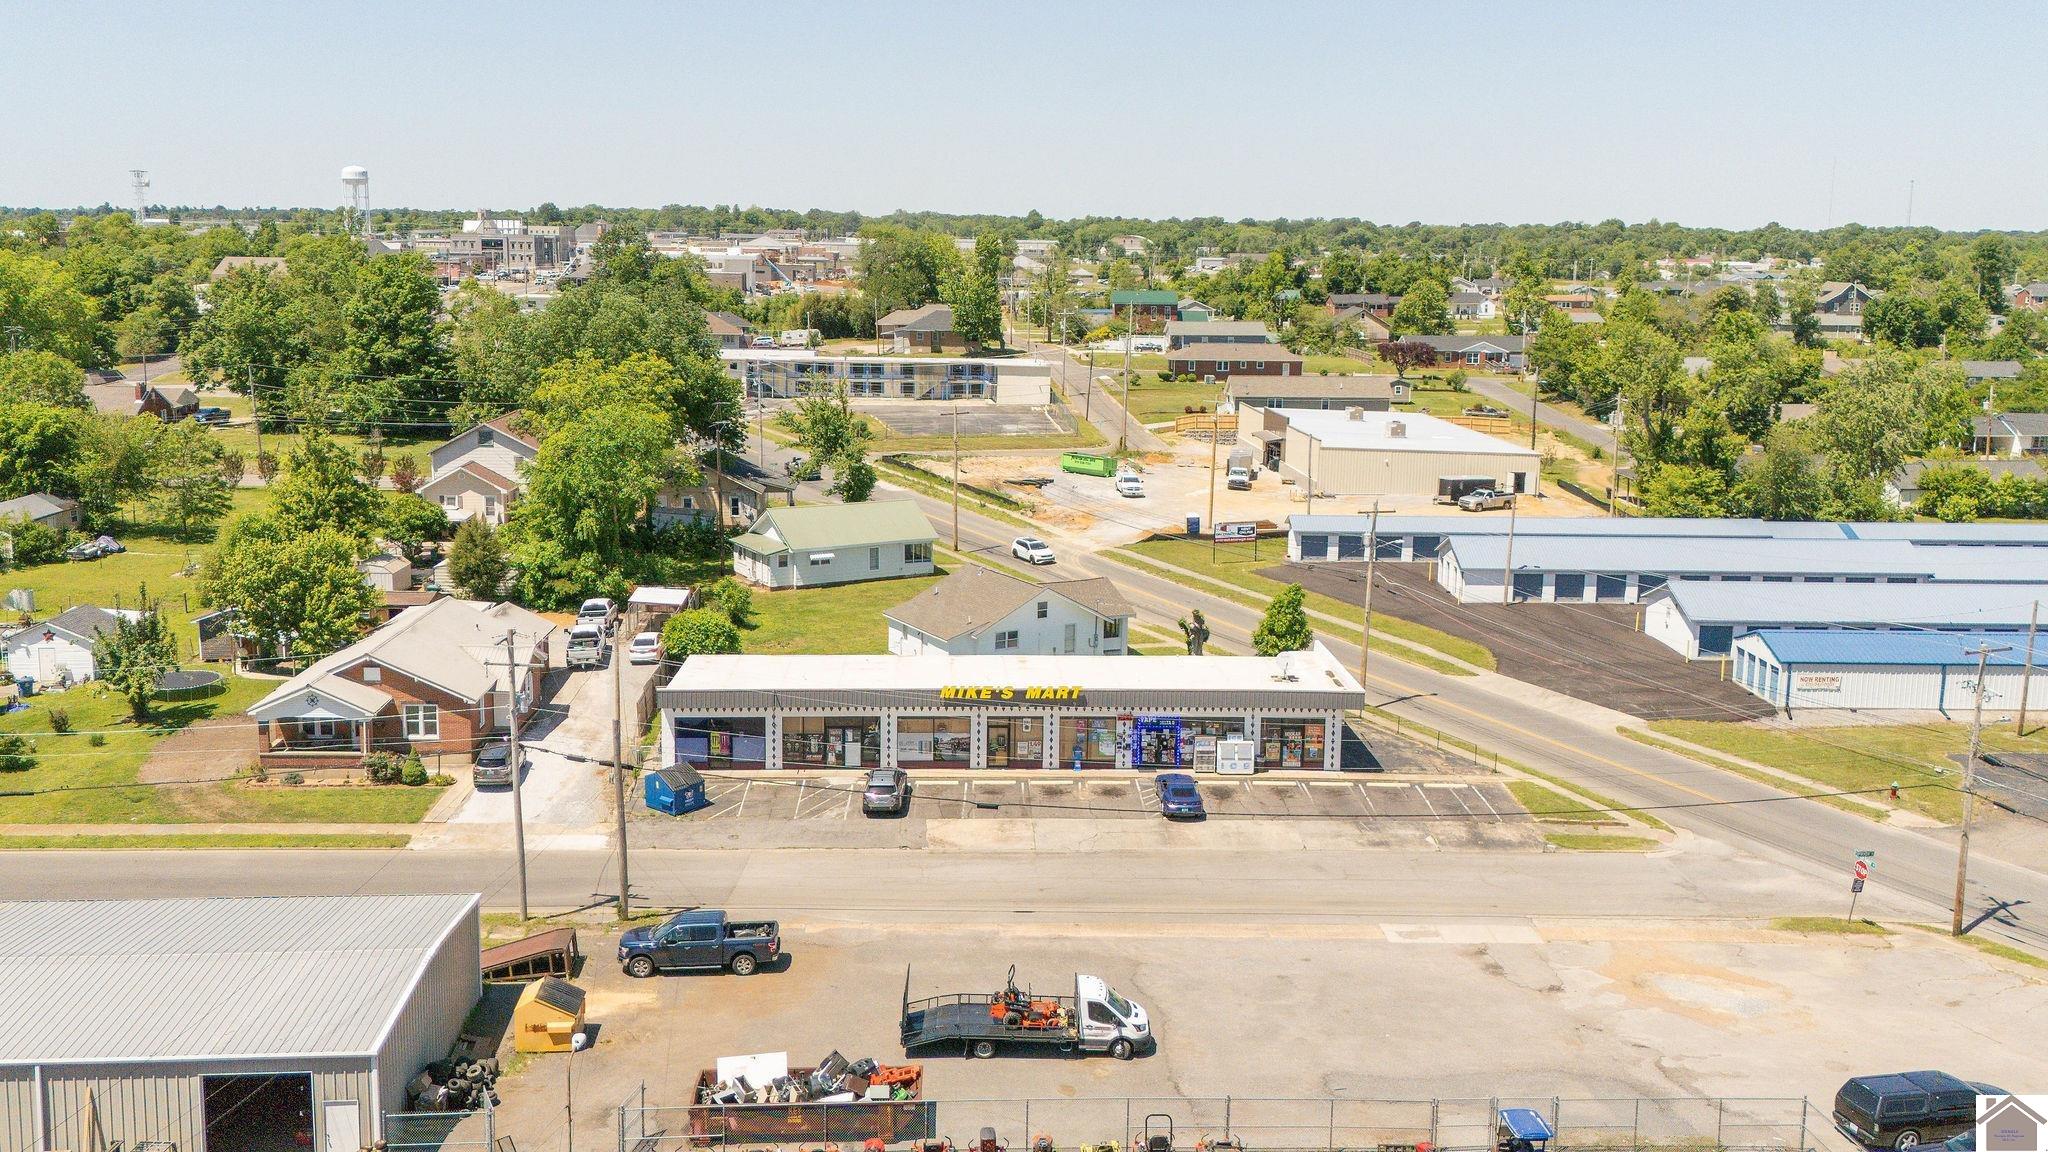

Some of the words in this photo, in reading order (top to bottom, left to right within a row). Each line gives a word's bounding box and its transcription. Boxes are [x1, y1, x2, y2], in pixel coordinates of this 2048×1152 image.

[940, 686, 1014, 699] MIKE'S
[1025, 686, 1082, 699] MART
[1855, 863, 1868, 874] STOP
